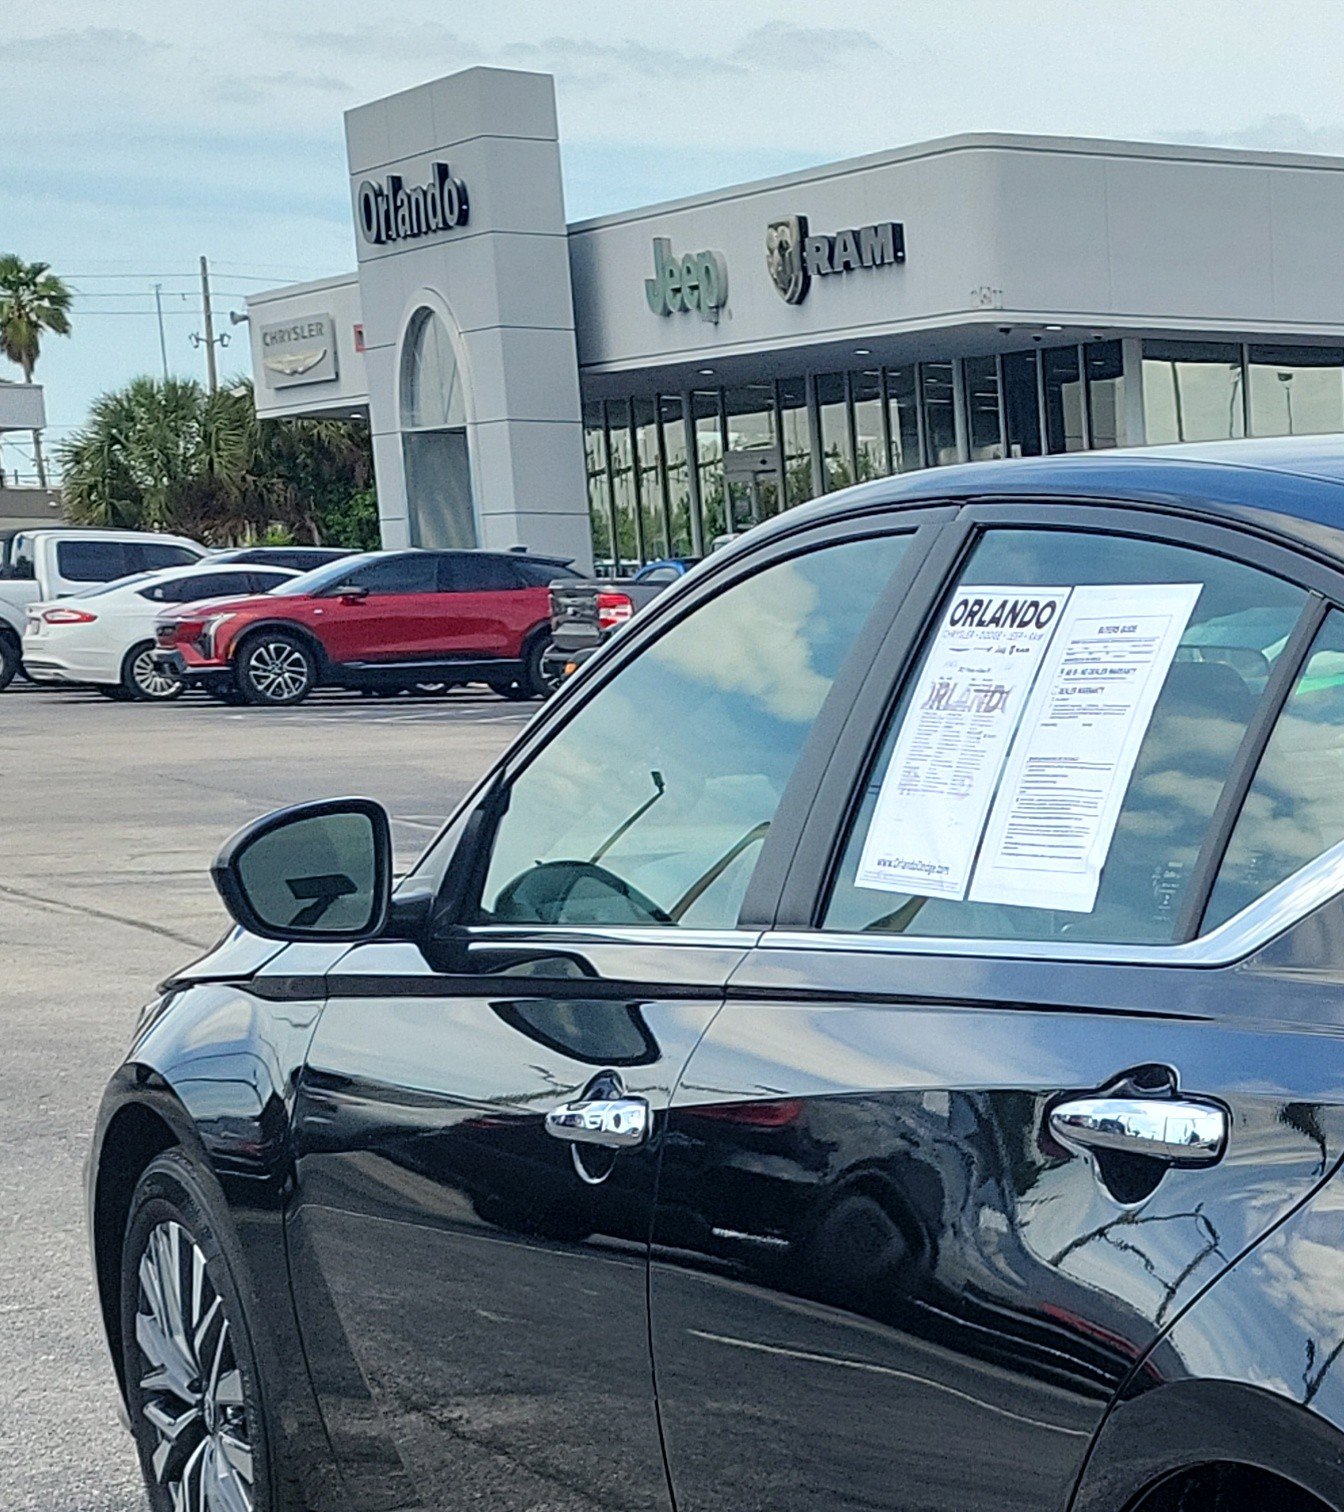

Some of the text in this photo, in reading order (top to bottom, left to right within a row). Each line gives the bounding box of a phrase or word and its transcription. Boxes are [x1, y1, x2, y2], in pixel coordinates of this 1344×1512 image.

[358, 162, 469, 245] Orlando
[804, 222, 904, 277] RAM
[645, 237, 728, 325] Jeep
[262, 322, 324, 347] CHRYSLER
[949, 598, 1057, 629] ORLANDO
